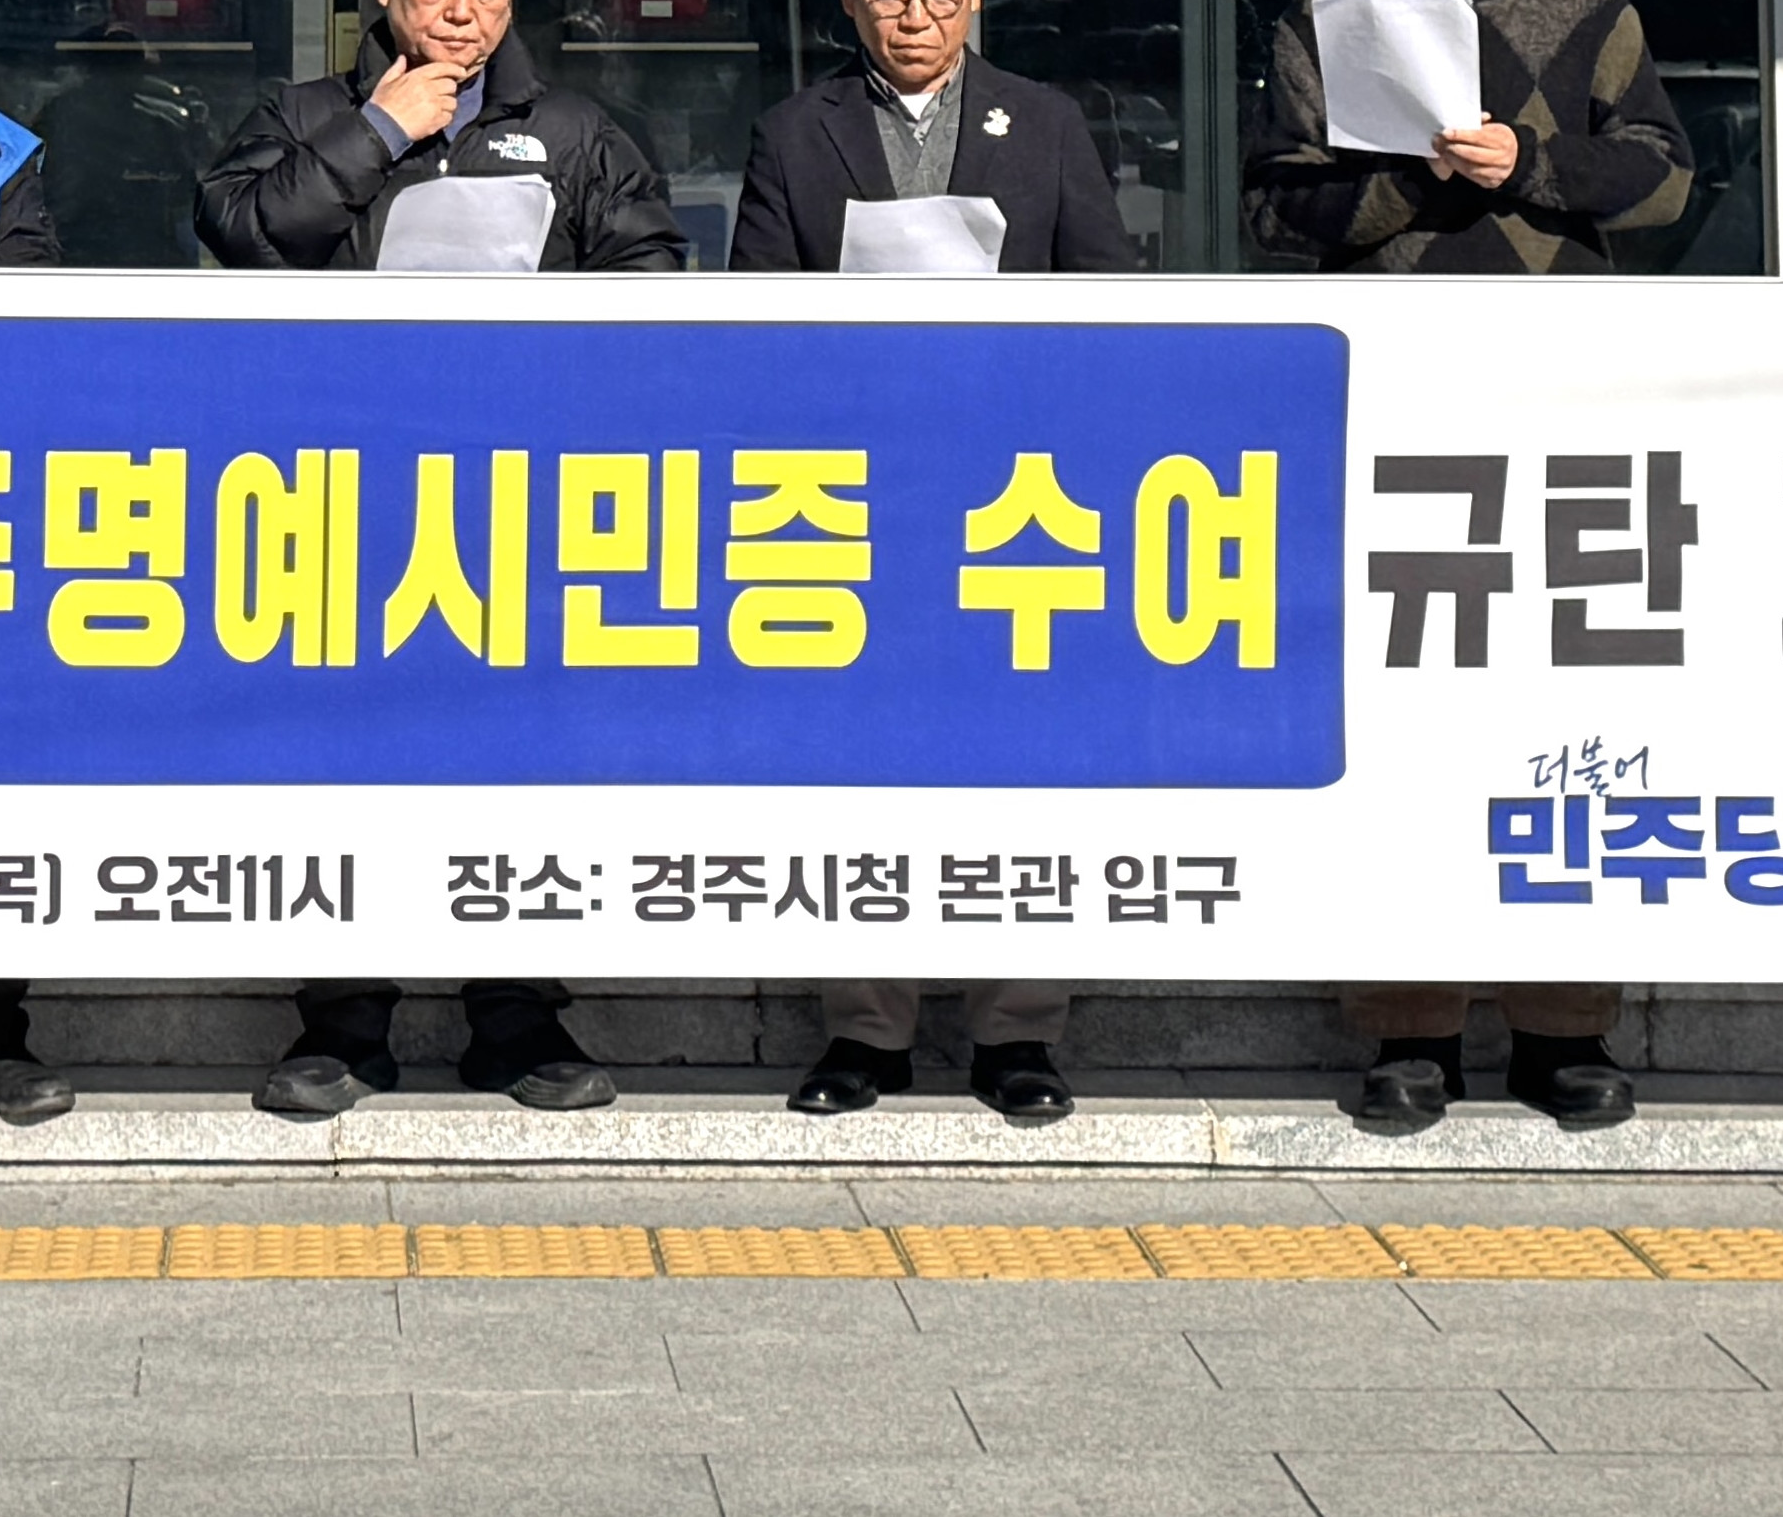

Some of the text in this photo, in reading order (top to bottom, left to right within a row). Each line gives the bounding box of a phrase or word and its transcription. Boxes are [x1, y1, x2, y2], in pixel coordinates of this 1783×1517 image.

[959, 450, 1278, 671] 수여
[1367, 450, 1699, 669] 규탄
[1527, 735, 1649, 797] 더불어
[92, 853, 357, 924] 오전11시
[447, 854, 603, 923] 장소:
[630, 854, 912, 924] 경주시청
[937, 854, 1080, 924] 본관
[1103, 854, 1242, 924] 입구
